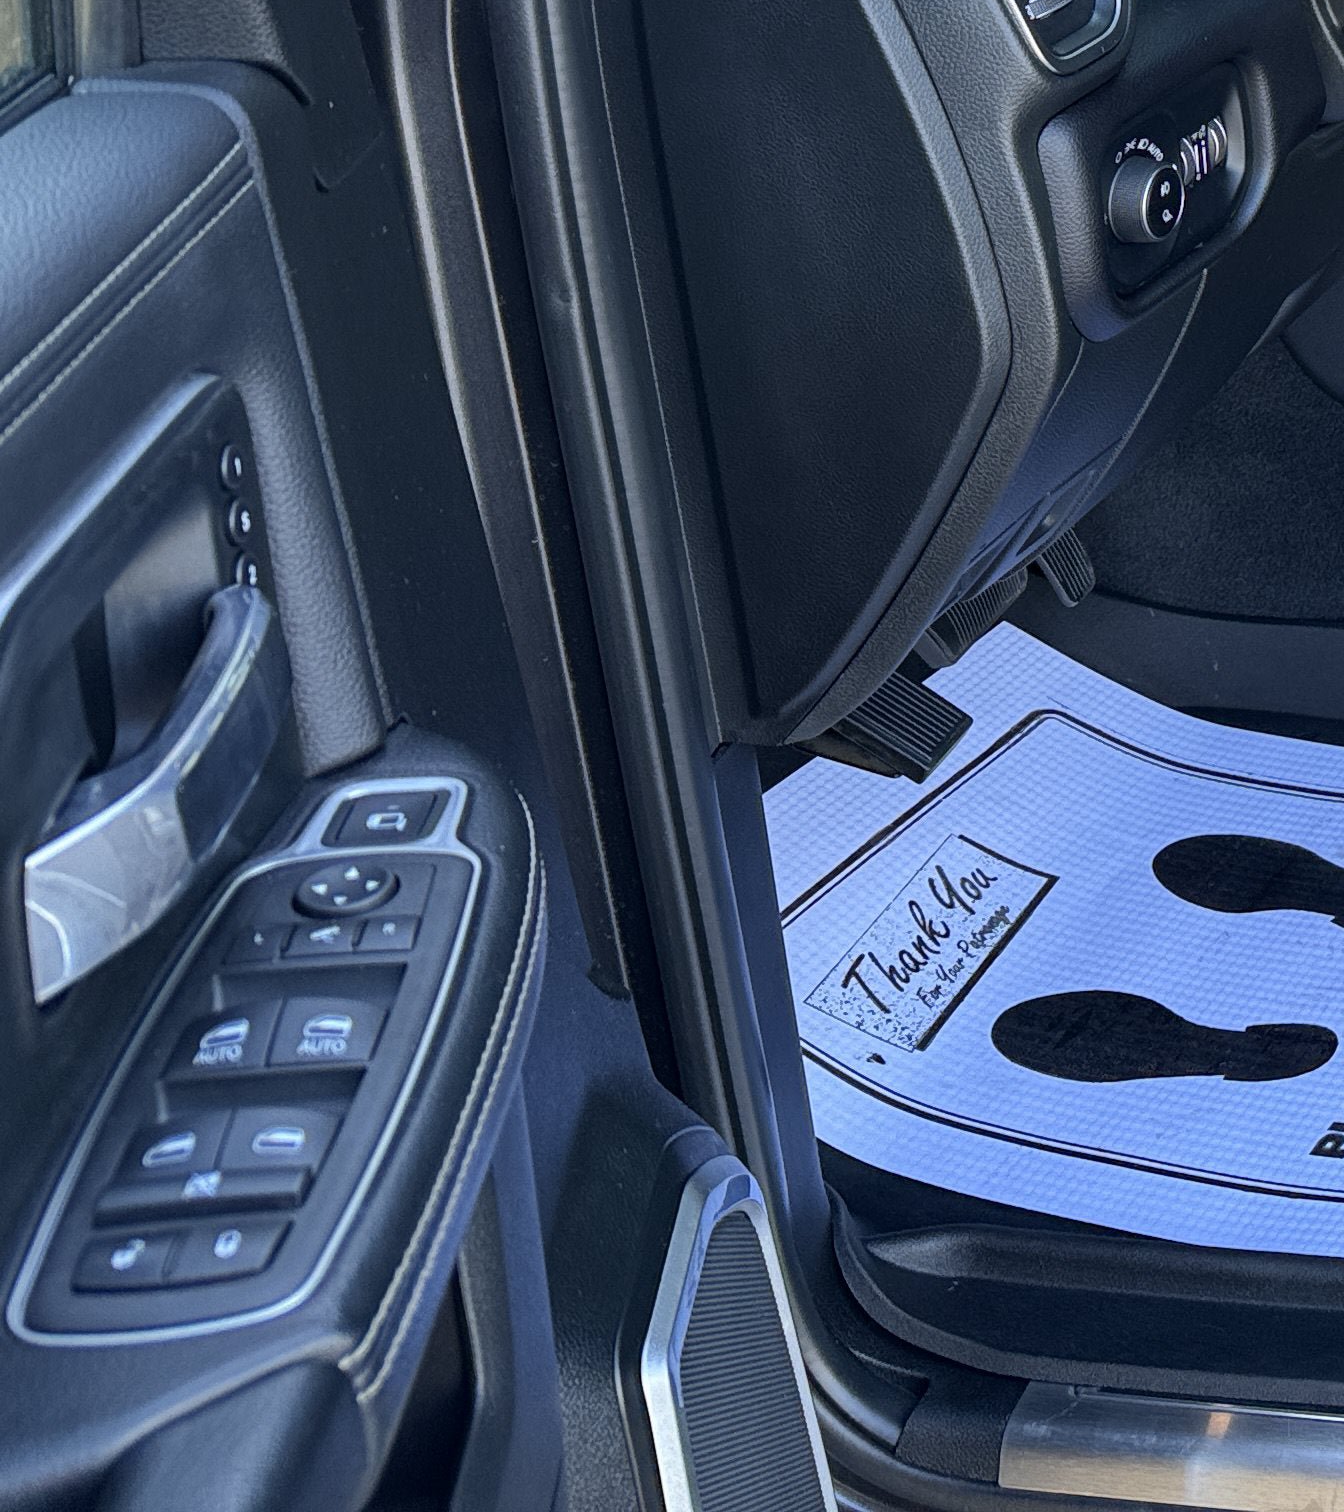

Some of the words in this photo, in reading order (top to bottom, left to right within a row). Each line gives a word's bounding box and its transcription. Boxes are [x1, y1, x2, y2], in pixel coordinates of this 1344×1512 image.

[841, 900, 950, 1014] Thank
[927, 864, 998, 915] You
[193, 1045, 243, 1065] AUTO
[297, 1038, 347, 1056] AUTO
